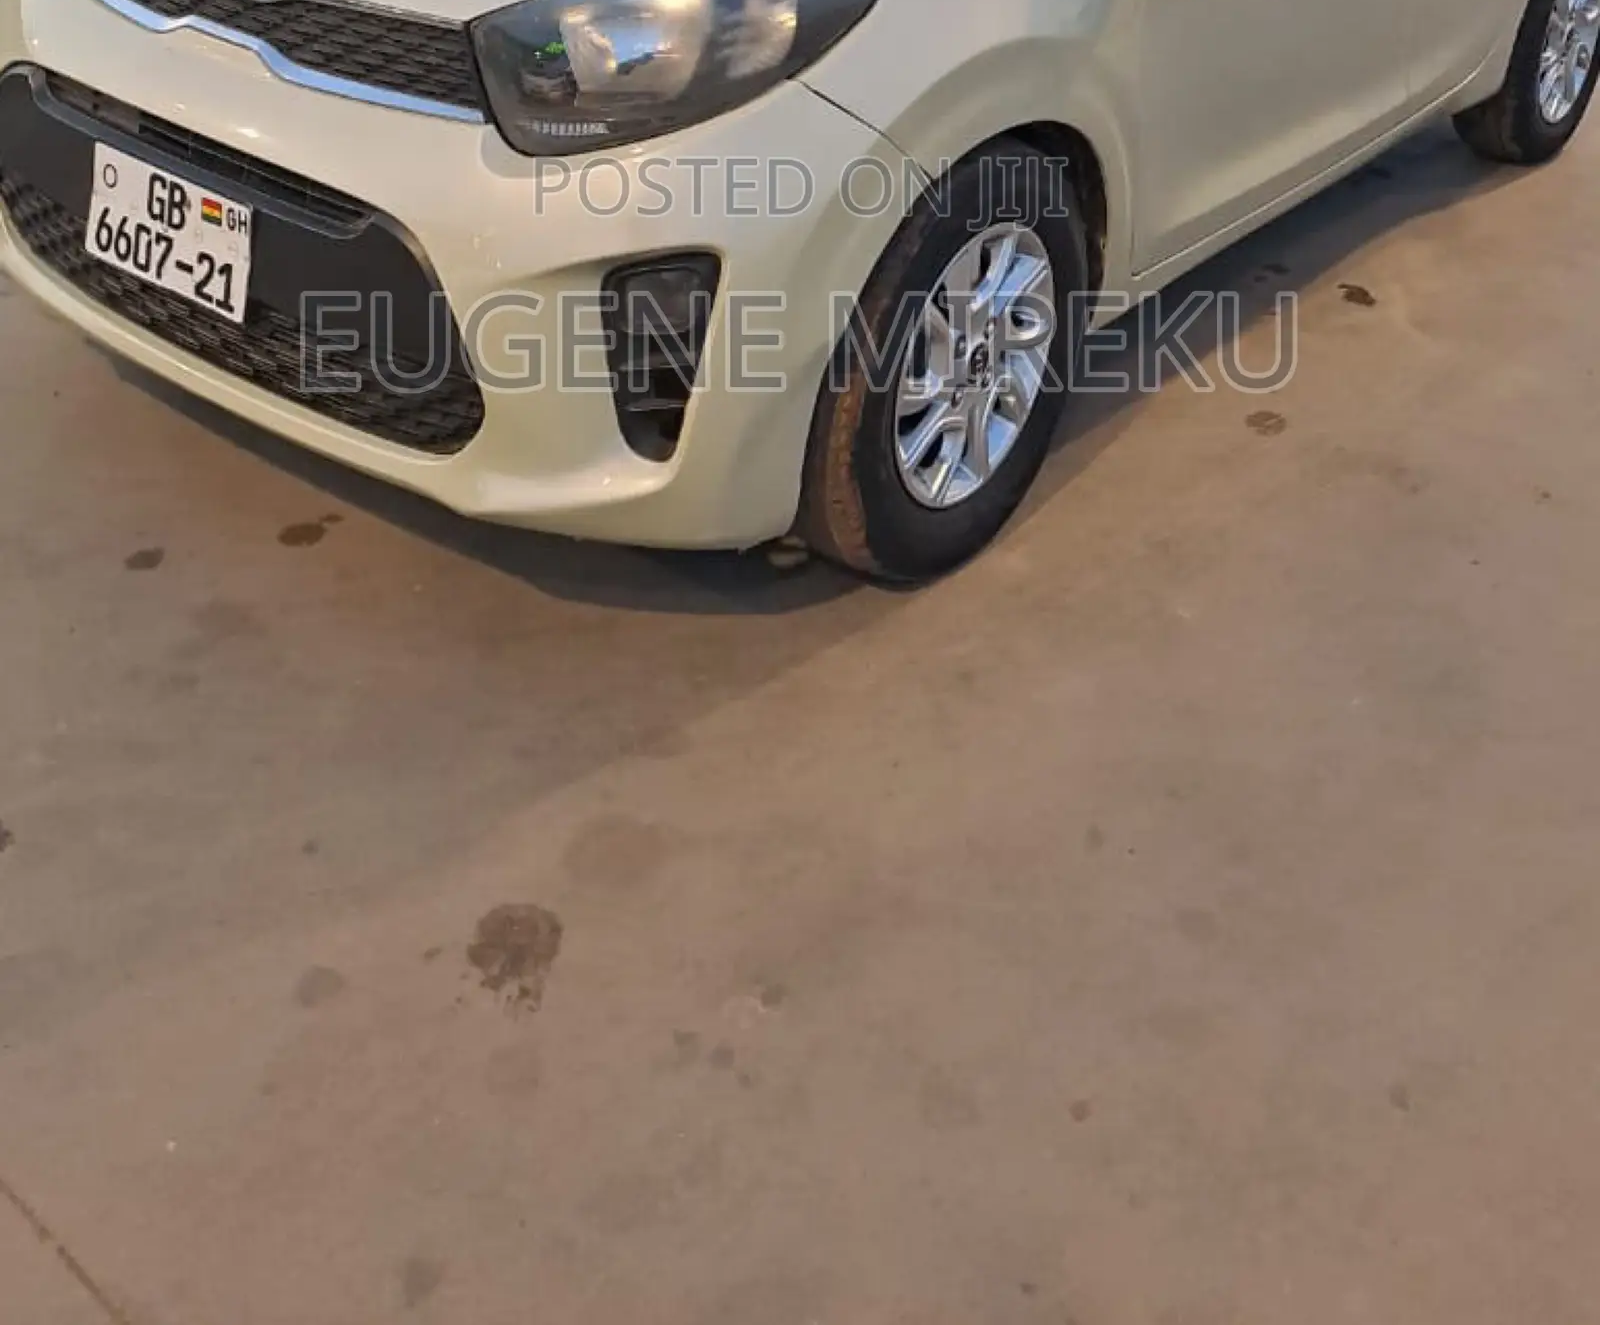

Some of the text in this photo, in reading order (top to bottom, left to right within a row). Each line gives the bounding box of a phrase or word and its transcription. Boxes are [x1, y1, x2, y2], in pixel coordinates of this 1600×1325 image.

[147, 173, 248, 234] GB GH
[95, 207, 235, 312] 6607-21
